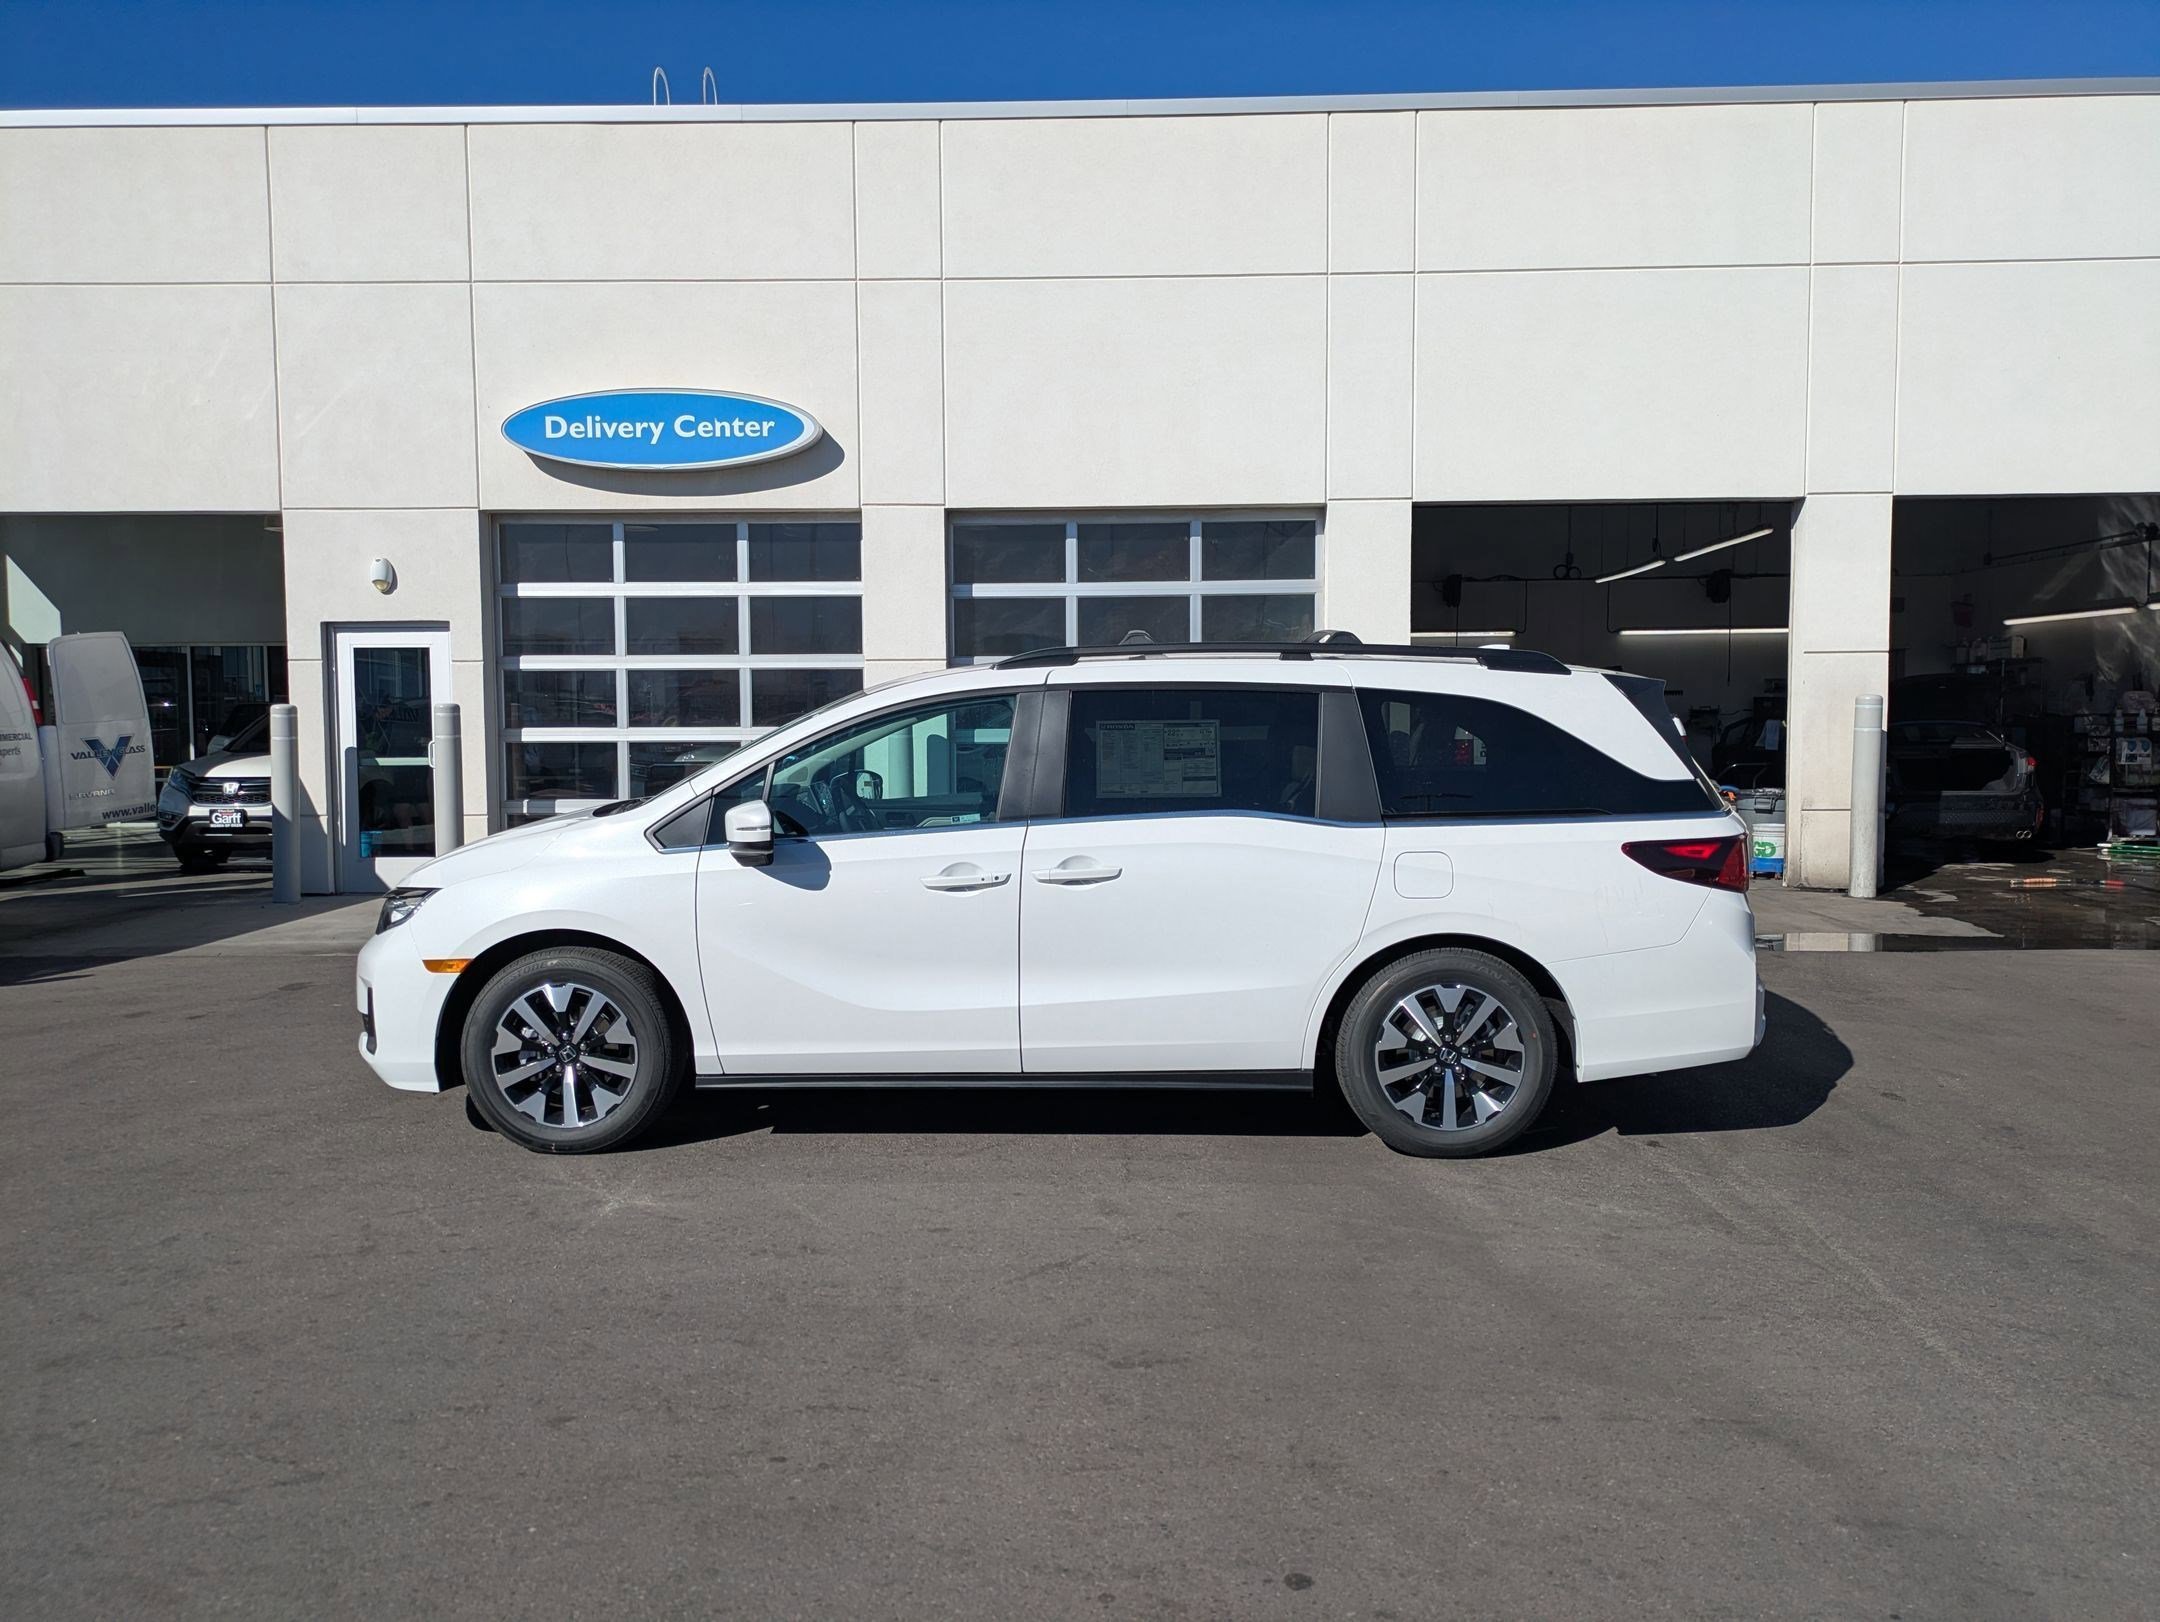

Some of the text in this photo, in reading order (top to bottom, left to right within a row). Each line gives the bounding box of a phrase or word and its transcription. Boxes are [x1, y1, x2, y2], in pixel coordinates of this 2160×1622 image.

[544, 415, 775, 444] Delivery Center
[70, 745, 146, 760] VALLEY GLASS
[102, 803, 156, 819] www.valle
[211, 812, 241, 824] Garff
